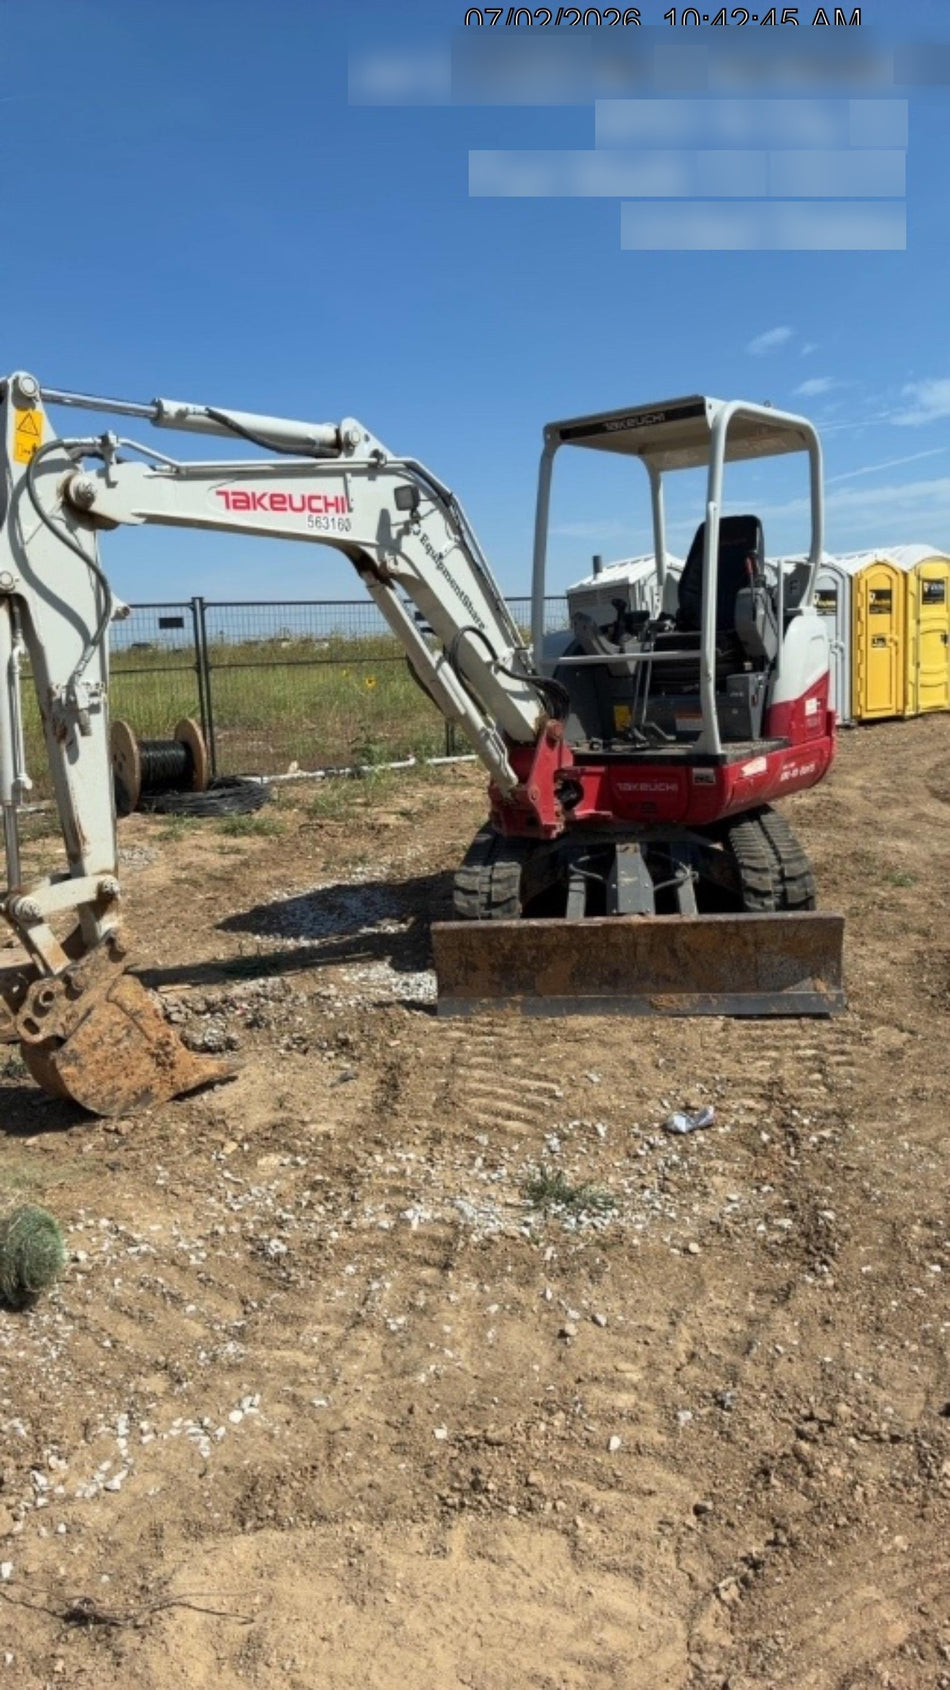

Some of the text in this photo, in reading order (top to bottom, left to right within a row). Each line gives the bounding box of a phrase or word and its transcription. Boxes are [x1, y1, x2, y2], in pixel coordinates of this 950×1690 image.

[215, 490, 346, 514] TAKEUCHI
[420, 533, 485, 629] EquipmentShare
[616, 782, 678, 792] TAKEUCHI
